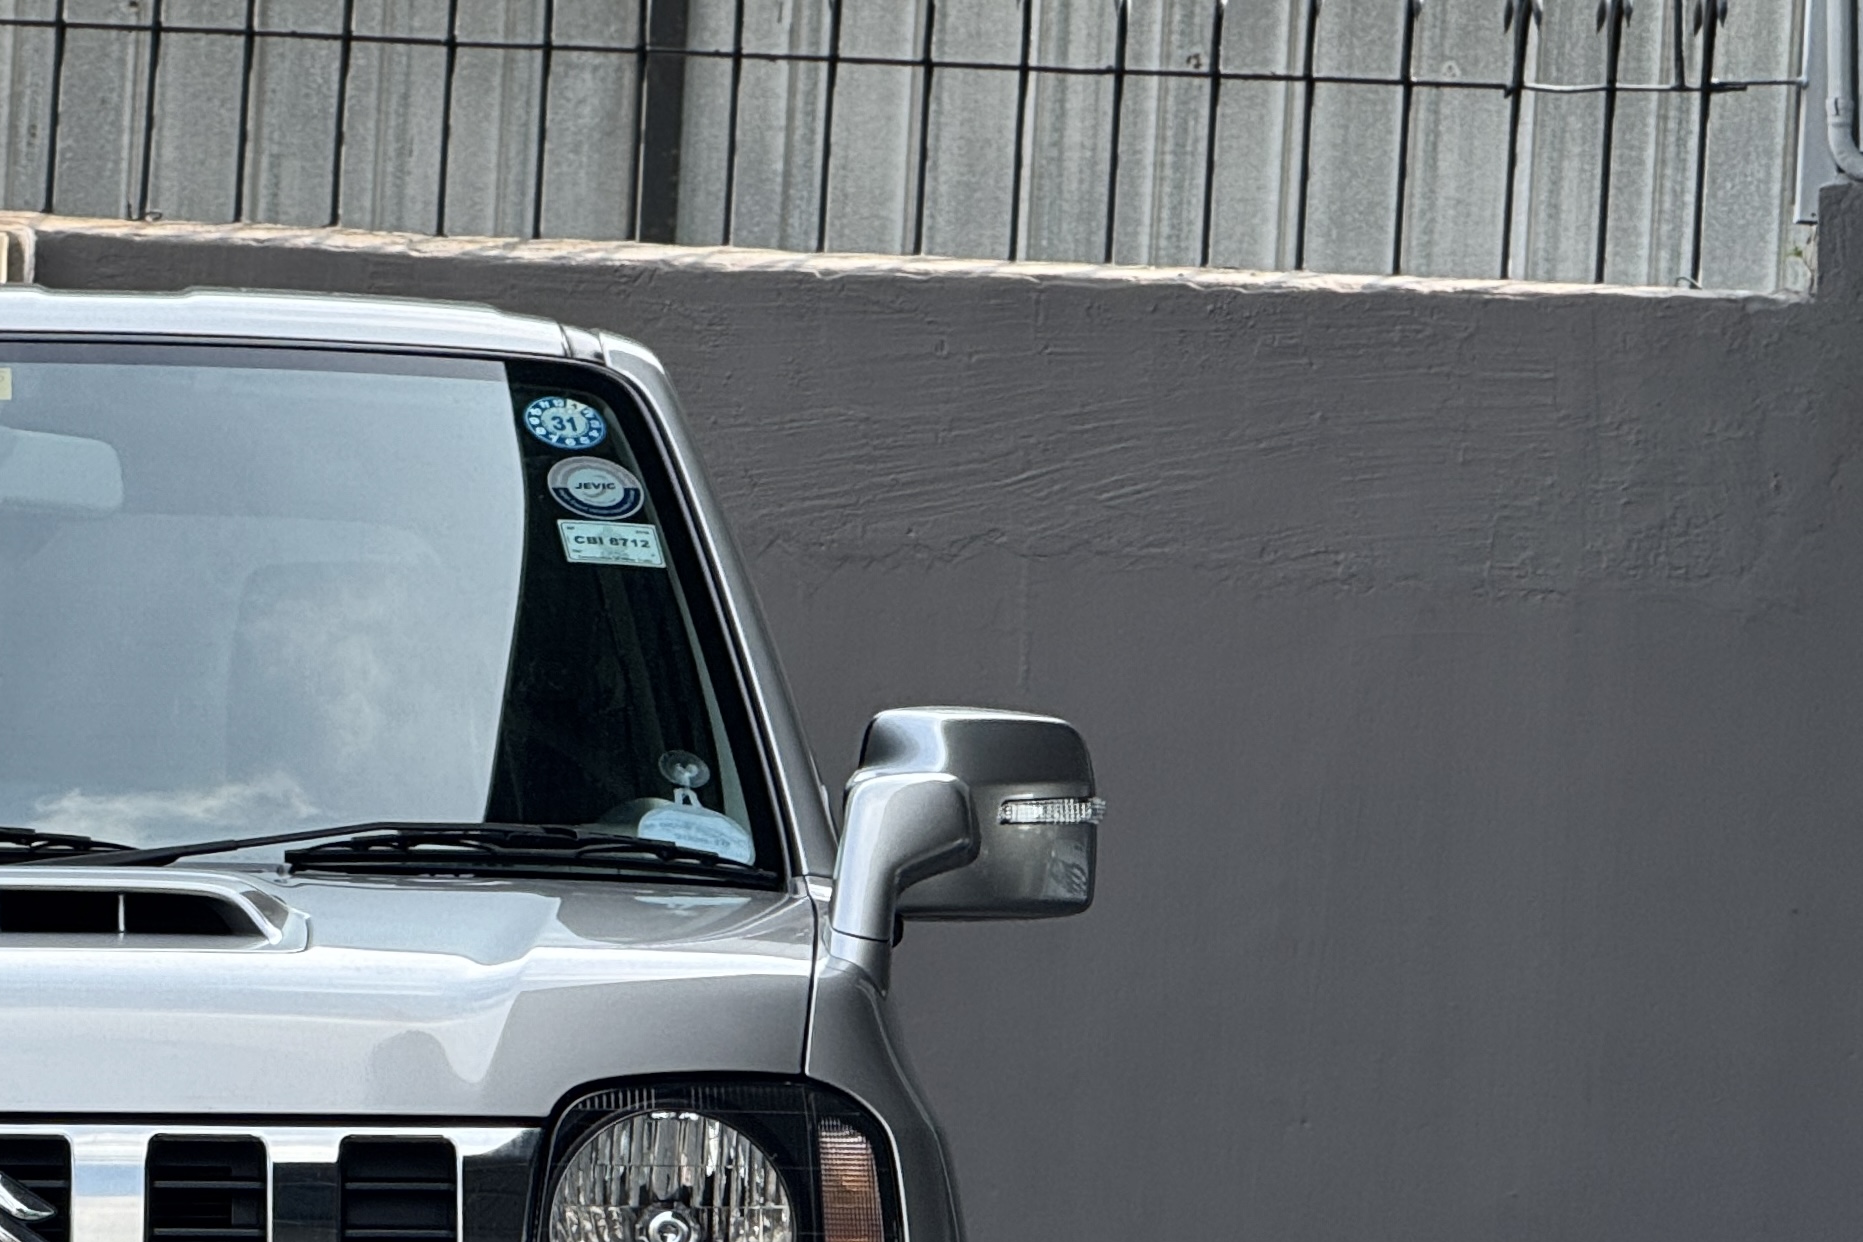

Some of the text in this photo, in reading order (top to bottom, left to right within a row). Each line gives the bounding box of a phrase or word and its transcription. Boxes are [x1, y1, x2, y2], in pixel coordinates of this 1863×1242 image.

[550, 416, 578, 432] 31
[574, 482, 616, 490] JEVIC
[574, 535, 651, 549] CBI 8712
